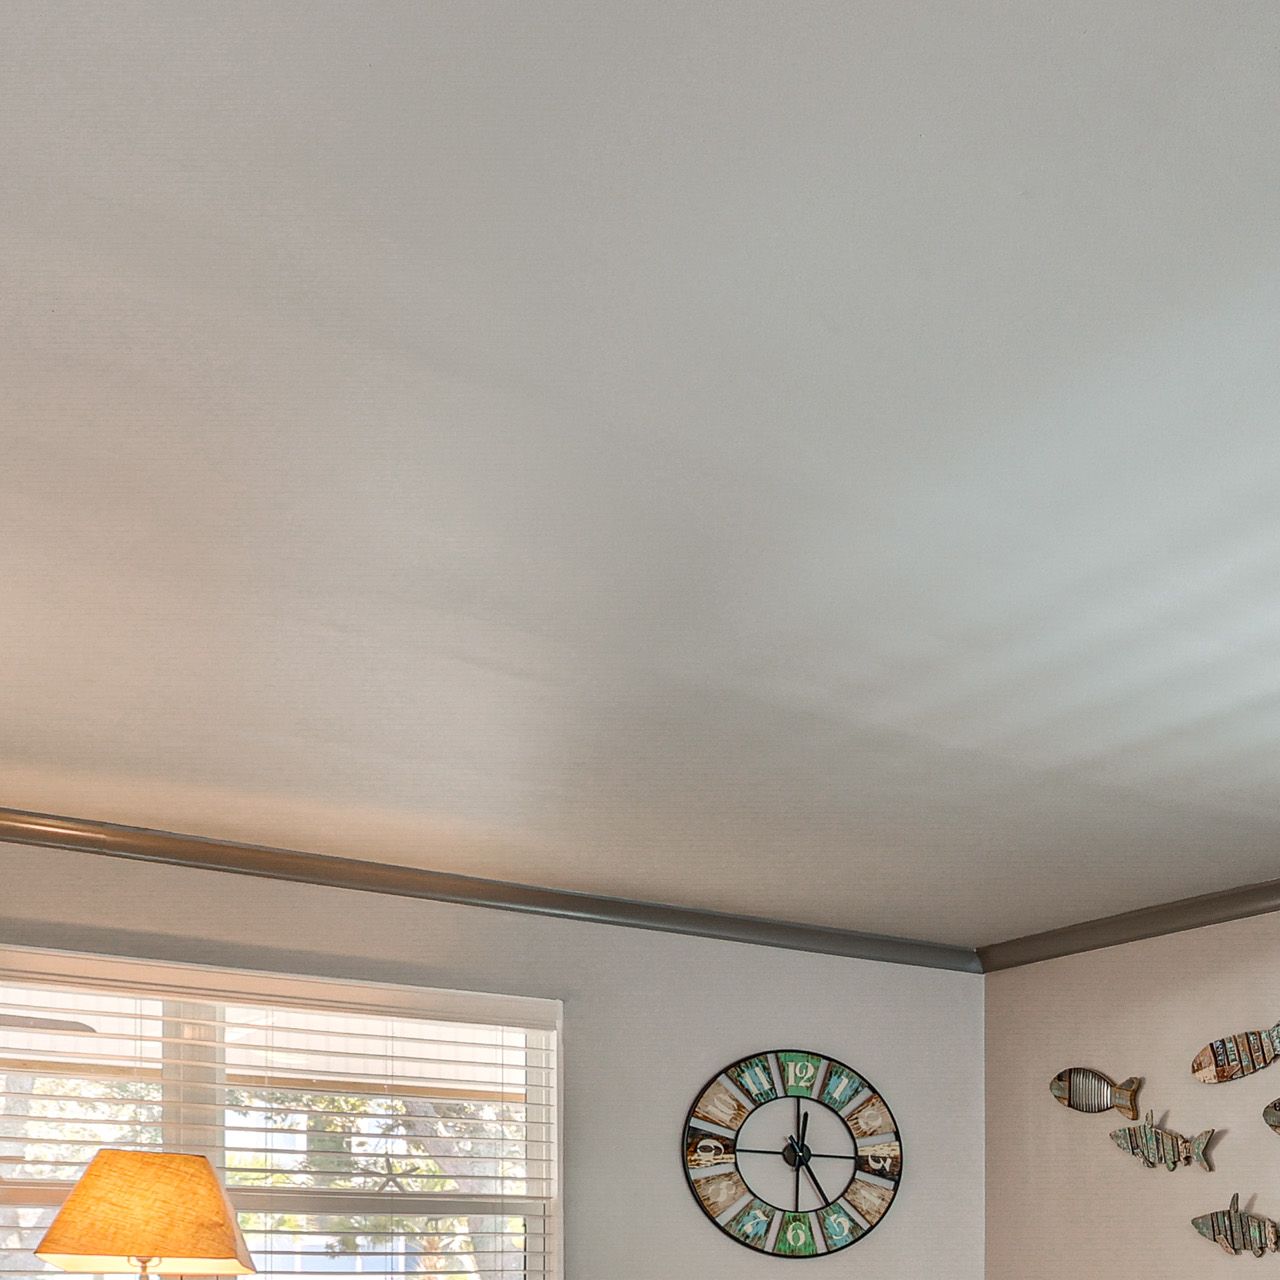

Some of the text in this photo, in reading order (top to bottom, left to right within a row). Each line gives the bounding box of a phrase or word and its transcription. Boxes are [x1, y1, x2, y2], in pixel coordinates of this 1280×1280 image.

[740, 1067, 772, 1096] 11
[786, 1061, 815, 1087] 12
[829, 1076, 849, 1100] 1
[696, 1138, 725, 1158] 9
[744, 1210, 769, 1233] 7
[830, 1215, 849, 1240] 5
[786, 1222, 806, 1246] 6
